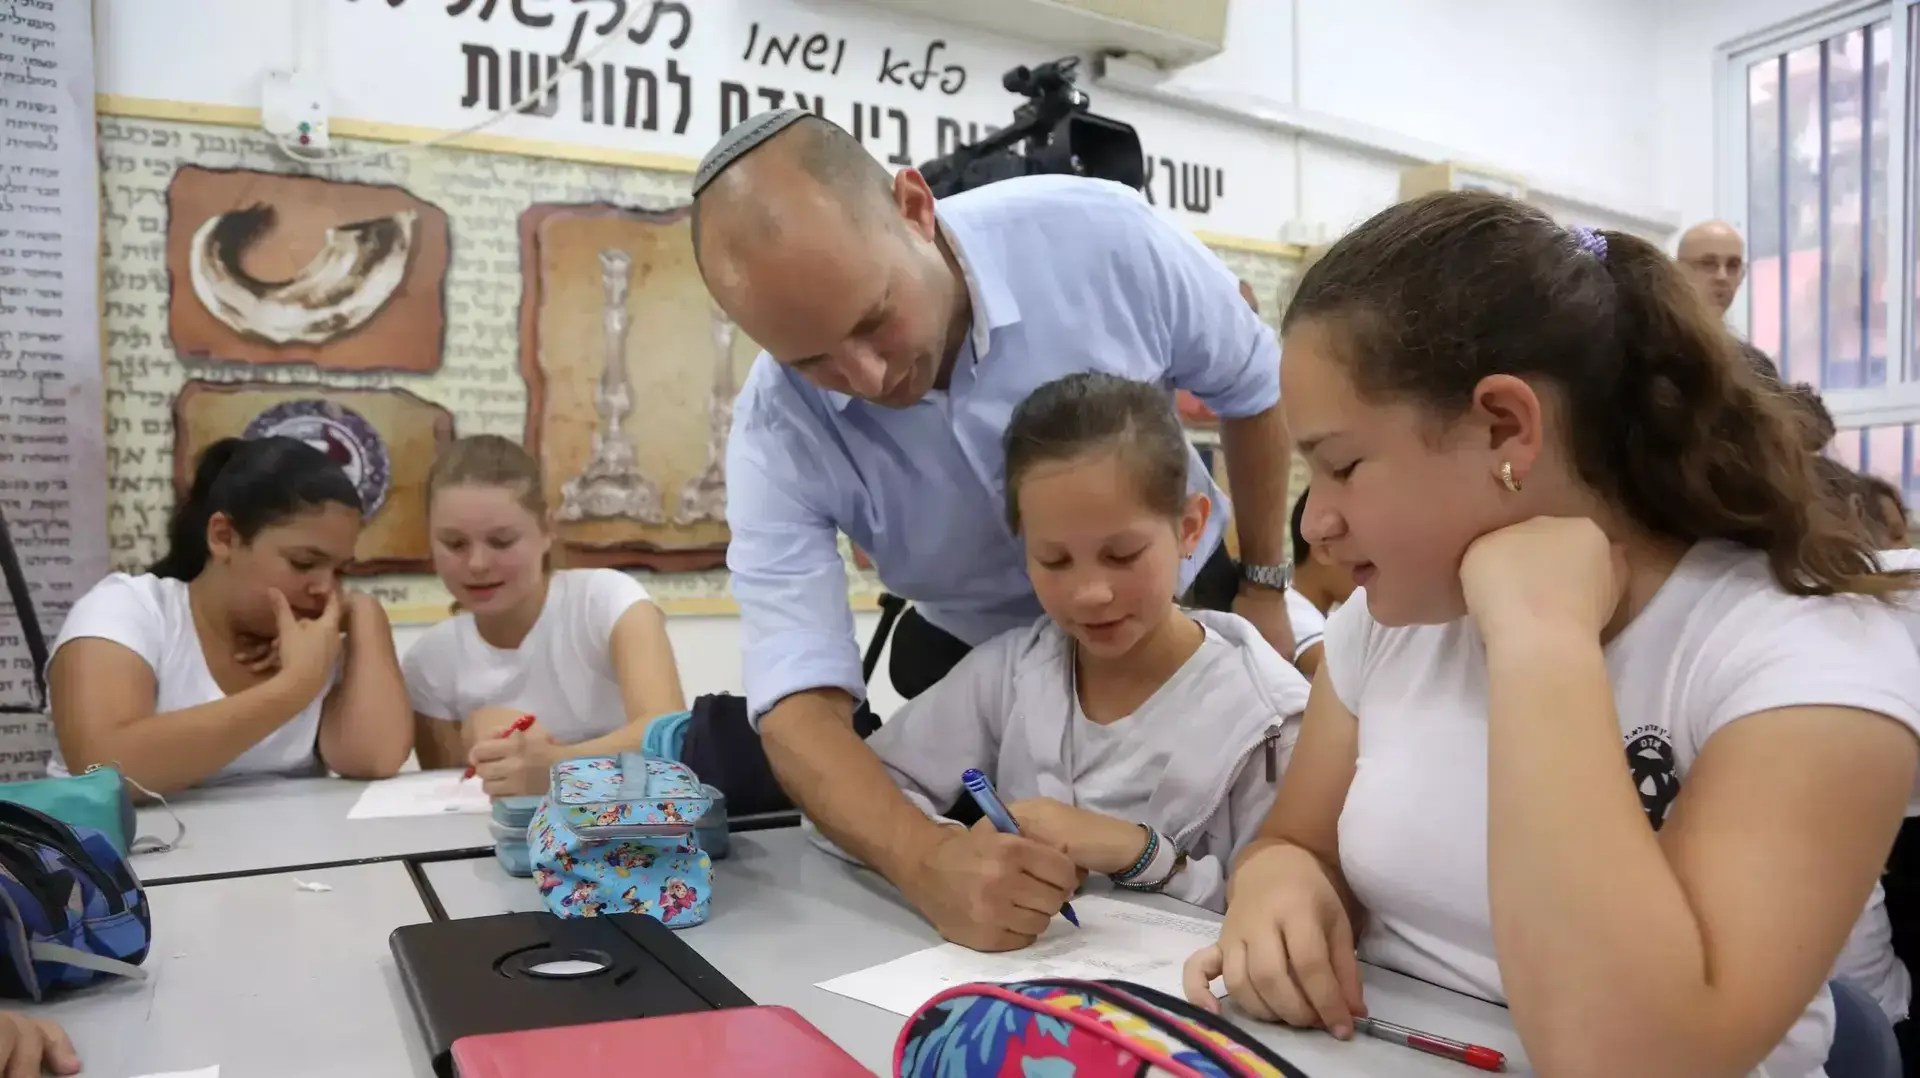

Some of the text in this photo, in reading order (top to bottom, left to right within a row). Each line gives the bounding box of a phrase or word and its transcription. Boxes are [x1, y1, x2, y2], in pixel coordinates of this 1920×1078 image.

[743, 23, 847, 75] ושמו
[878, 40, 976, 94] פלא
[461, 43, 692, 134] למורשת
[1143, 154, 1223, 213] ישרא
